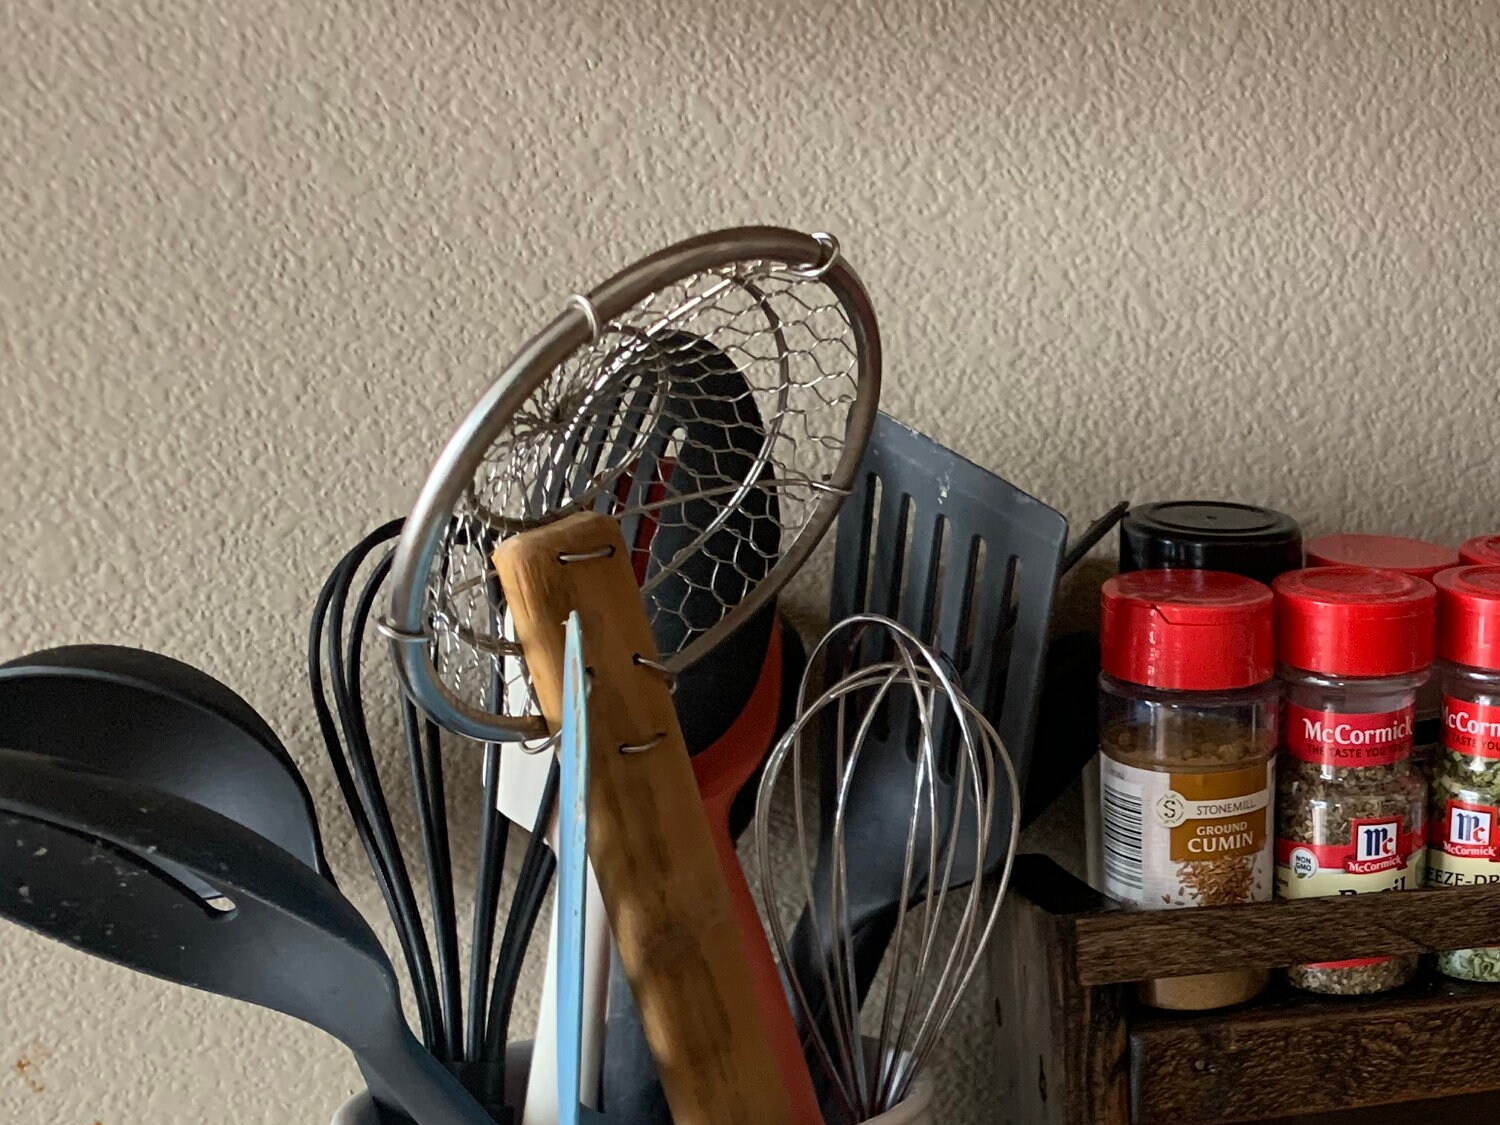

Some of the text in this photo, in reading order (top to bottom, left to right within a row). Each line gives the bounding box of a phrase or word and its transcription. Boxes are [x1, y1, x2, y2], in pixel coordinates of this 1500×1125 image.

[1302, 716, 1413, 745] McCormick
[1196, 801, 1256, 816] STONEMILL
[1196, 821, 1248, 836] GROUND
[1187, 832, 1254, 853] CUMIN
[1443, 841, 1495, 857] McCormick
[1295, 854, 1312, 865] NON
[1295, 862, 1312, 872] GMO
[1348, 854, 1402, 873] McCormick
